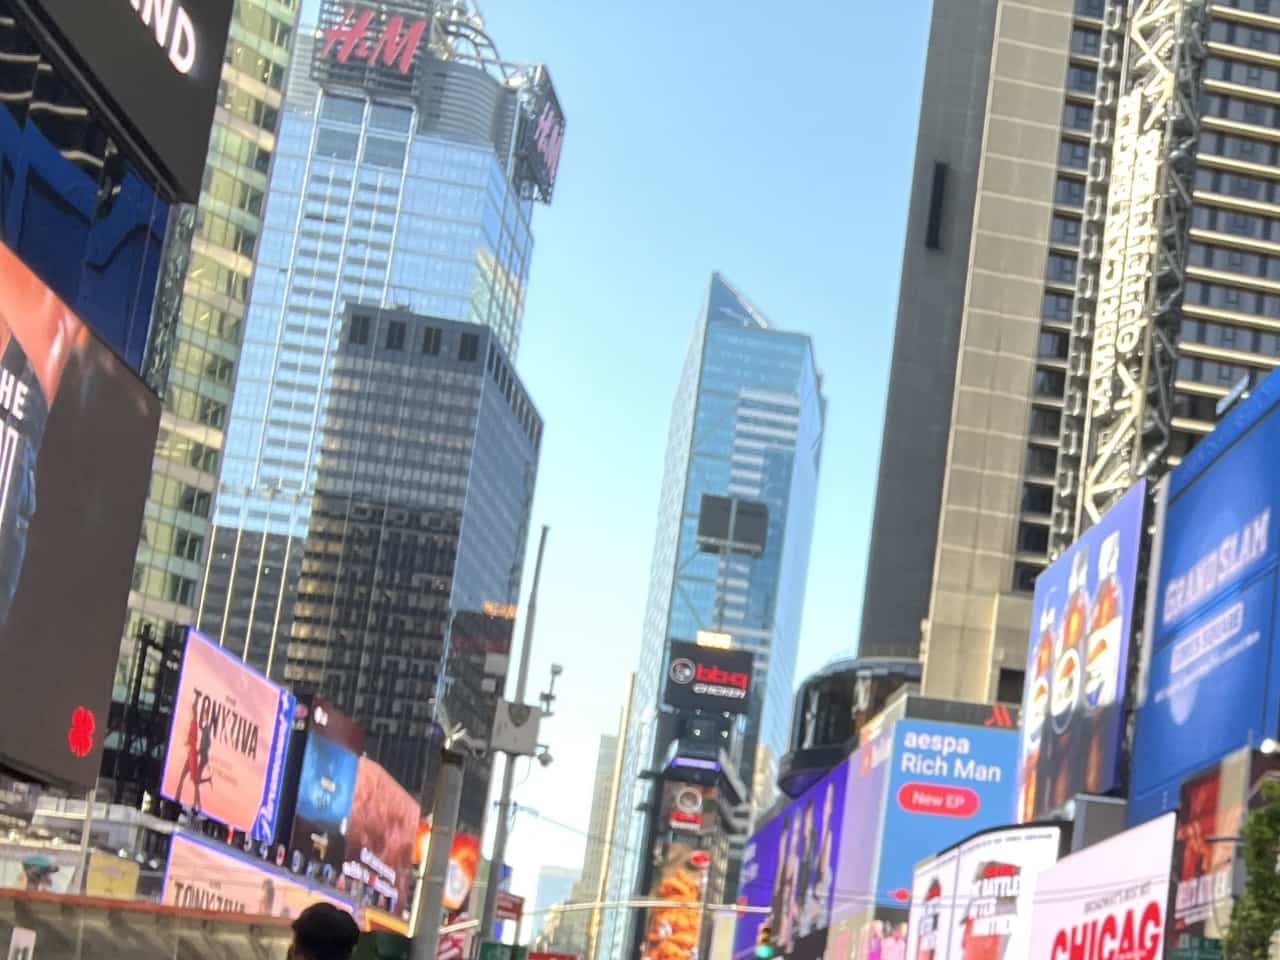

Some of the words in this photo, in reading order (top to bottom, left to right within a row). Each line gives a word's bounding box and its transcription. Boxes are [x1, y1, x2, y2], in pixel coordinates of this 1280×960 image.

[320, 8, 427, 75] H&M
[904, 731, 970, 757] aespa
[901, 751, 949, 777] Rich
[953, 757, 1002, 783] Man
[911, 790, 944, 807] New
[945, 794, 965, 809] EP
